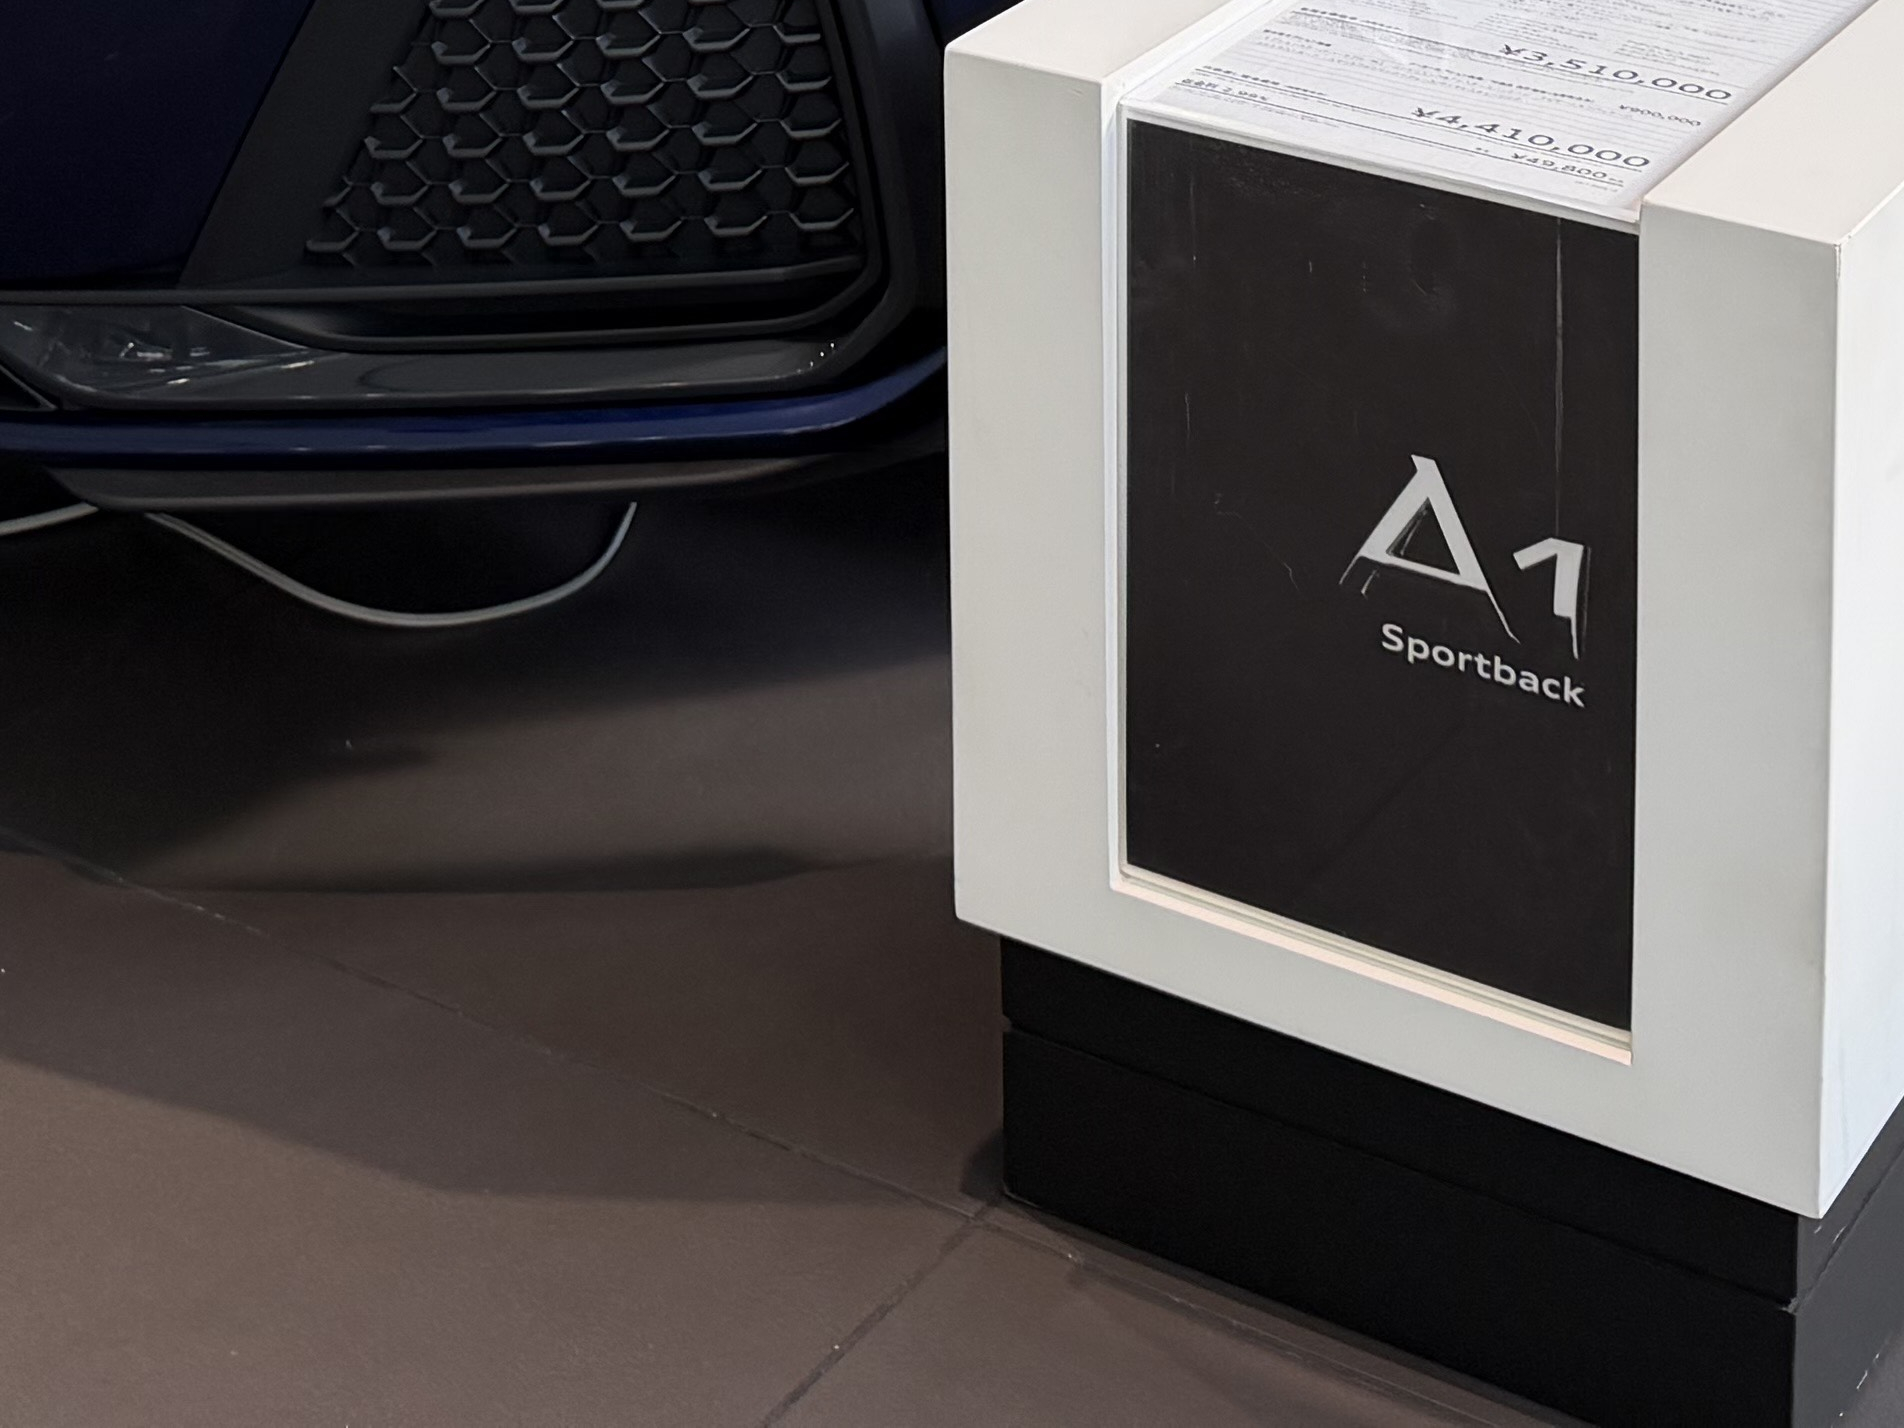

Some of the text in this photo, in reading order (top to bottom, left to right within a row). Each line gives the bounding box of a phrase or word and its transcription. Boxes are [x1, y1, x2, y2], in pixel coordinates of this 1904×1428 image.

[1499, 44, 1732, 101] ¥3,510,000
[1411, 107, 1650, 167] ¥4,410,000
[1339, 453, 1589, 660] A1
[1381, 622, 1586, 709] Sportback
